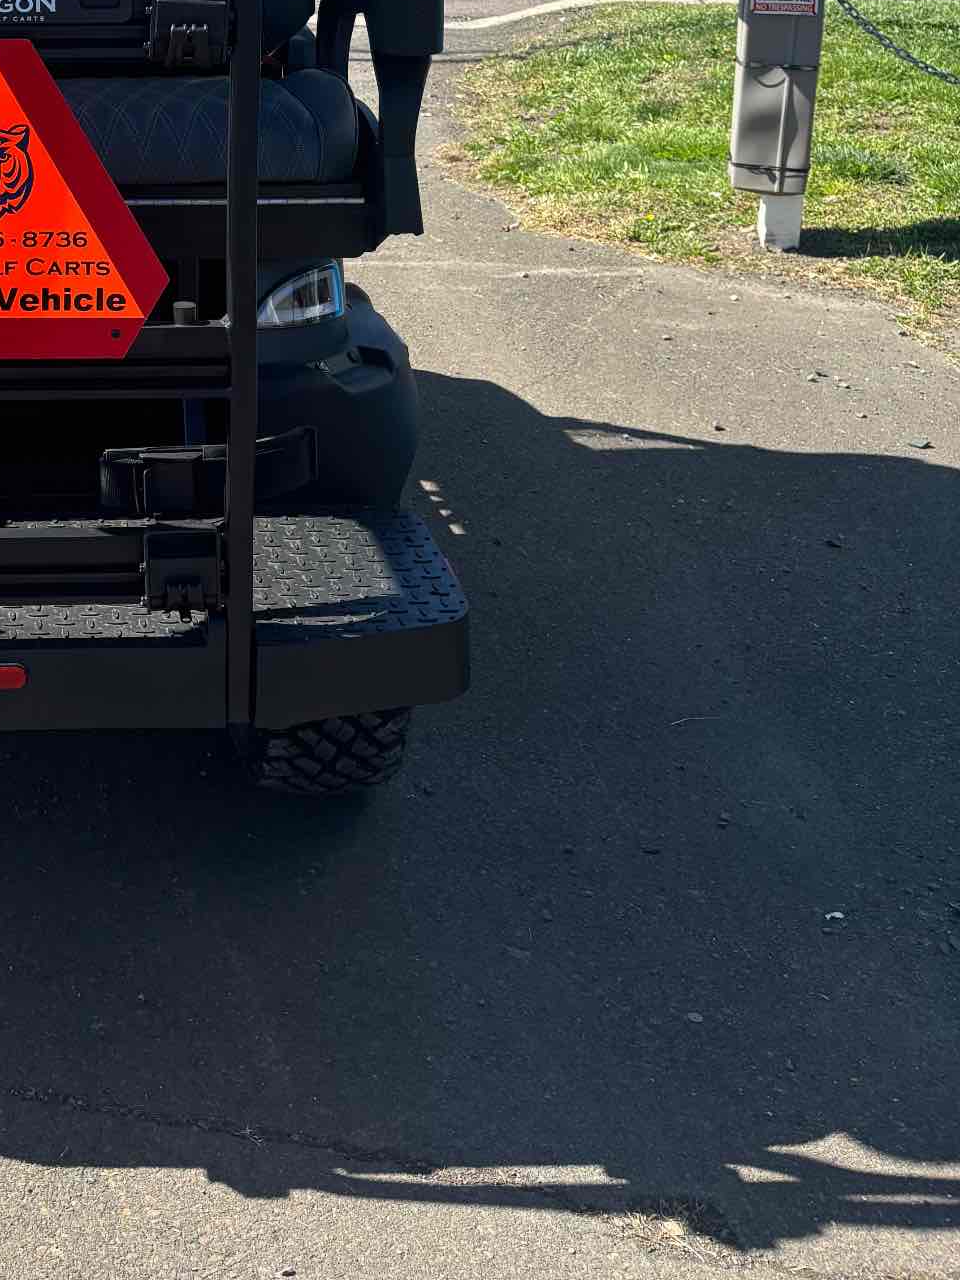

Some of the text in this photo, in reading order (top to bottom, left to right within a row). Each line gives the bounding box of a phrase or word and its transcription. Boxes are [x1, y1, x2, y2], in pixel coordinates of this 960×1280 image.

[755, 3, 813, 12] NO TRESPASSING
[25, 257, 110, 276] CARTS
